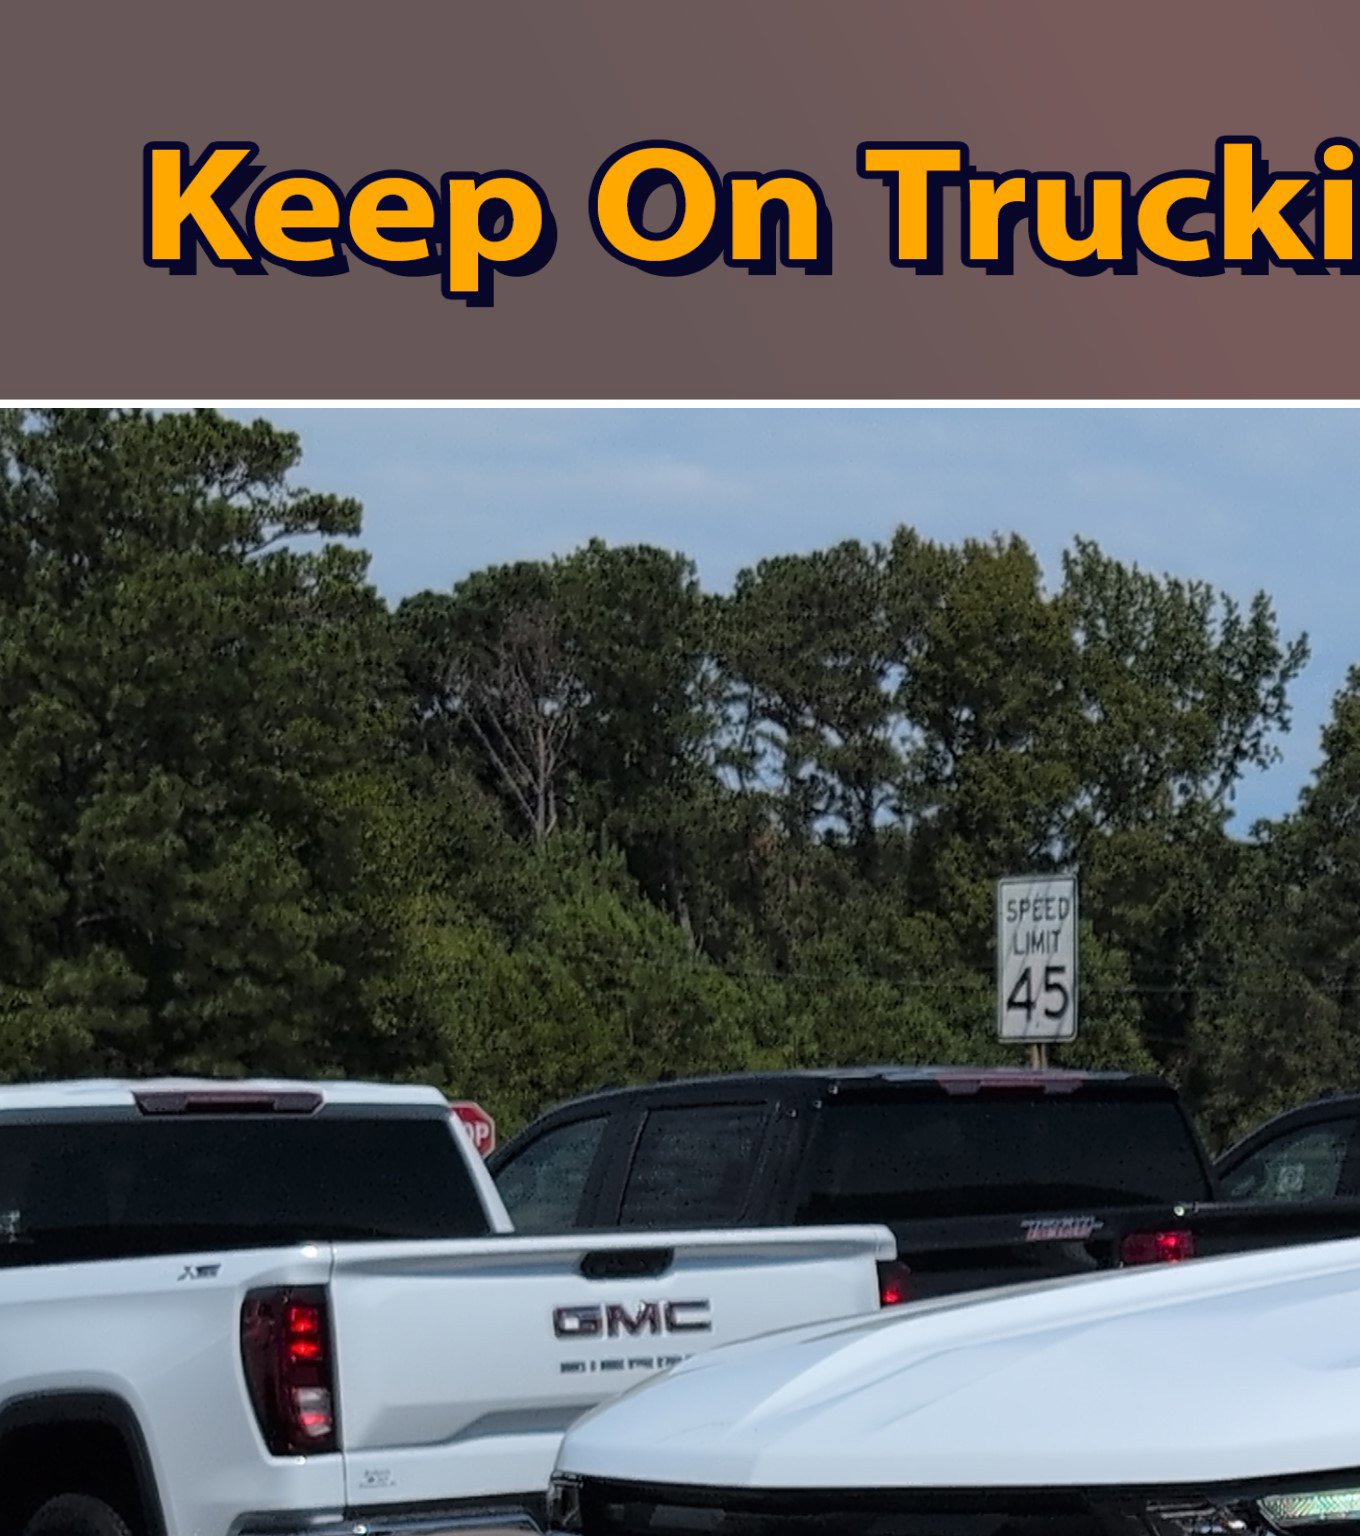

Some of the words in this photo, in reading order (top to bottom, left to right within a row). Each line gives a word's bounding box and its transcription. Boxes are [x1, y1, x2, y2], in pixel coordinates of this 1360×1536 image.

[1006, 897, 1070, 922] SPEED
[1012, 930, 1062, 955] LIMIT
[1006, 966, 1069, 1022] 45
[553, 1299, 712, 1340] GMC
